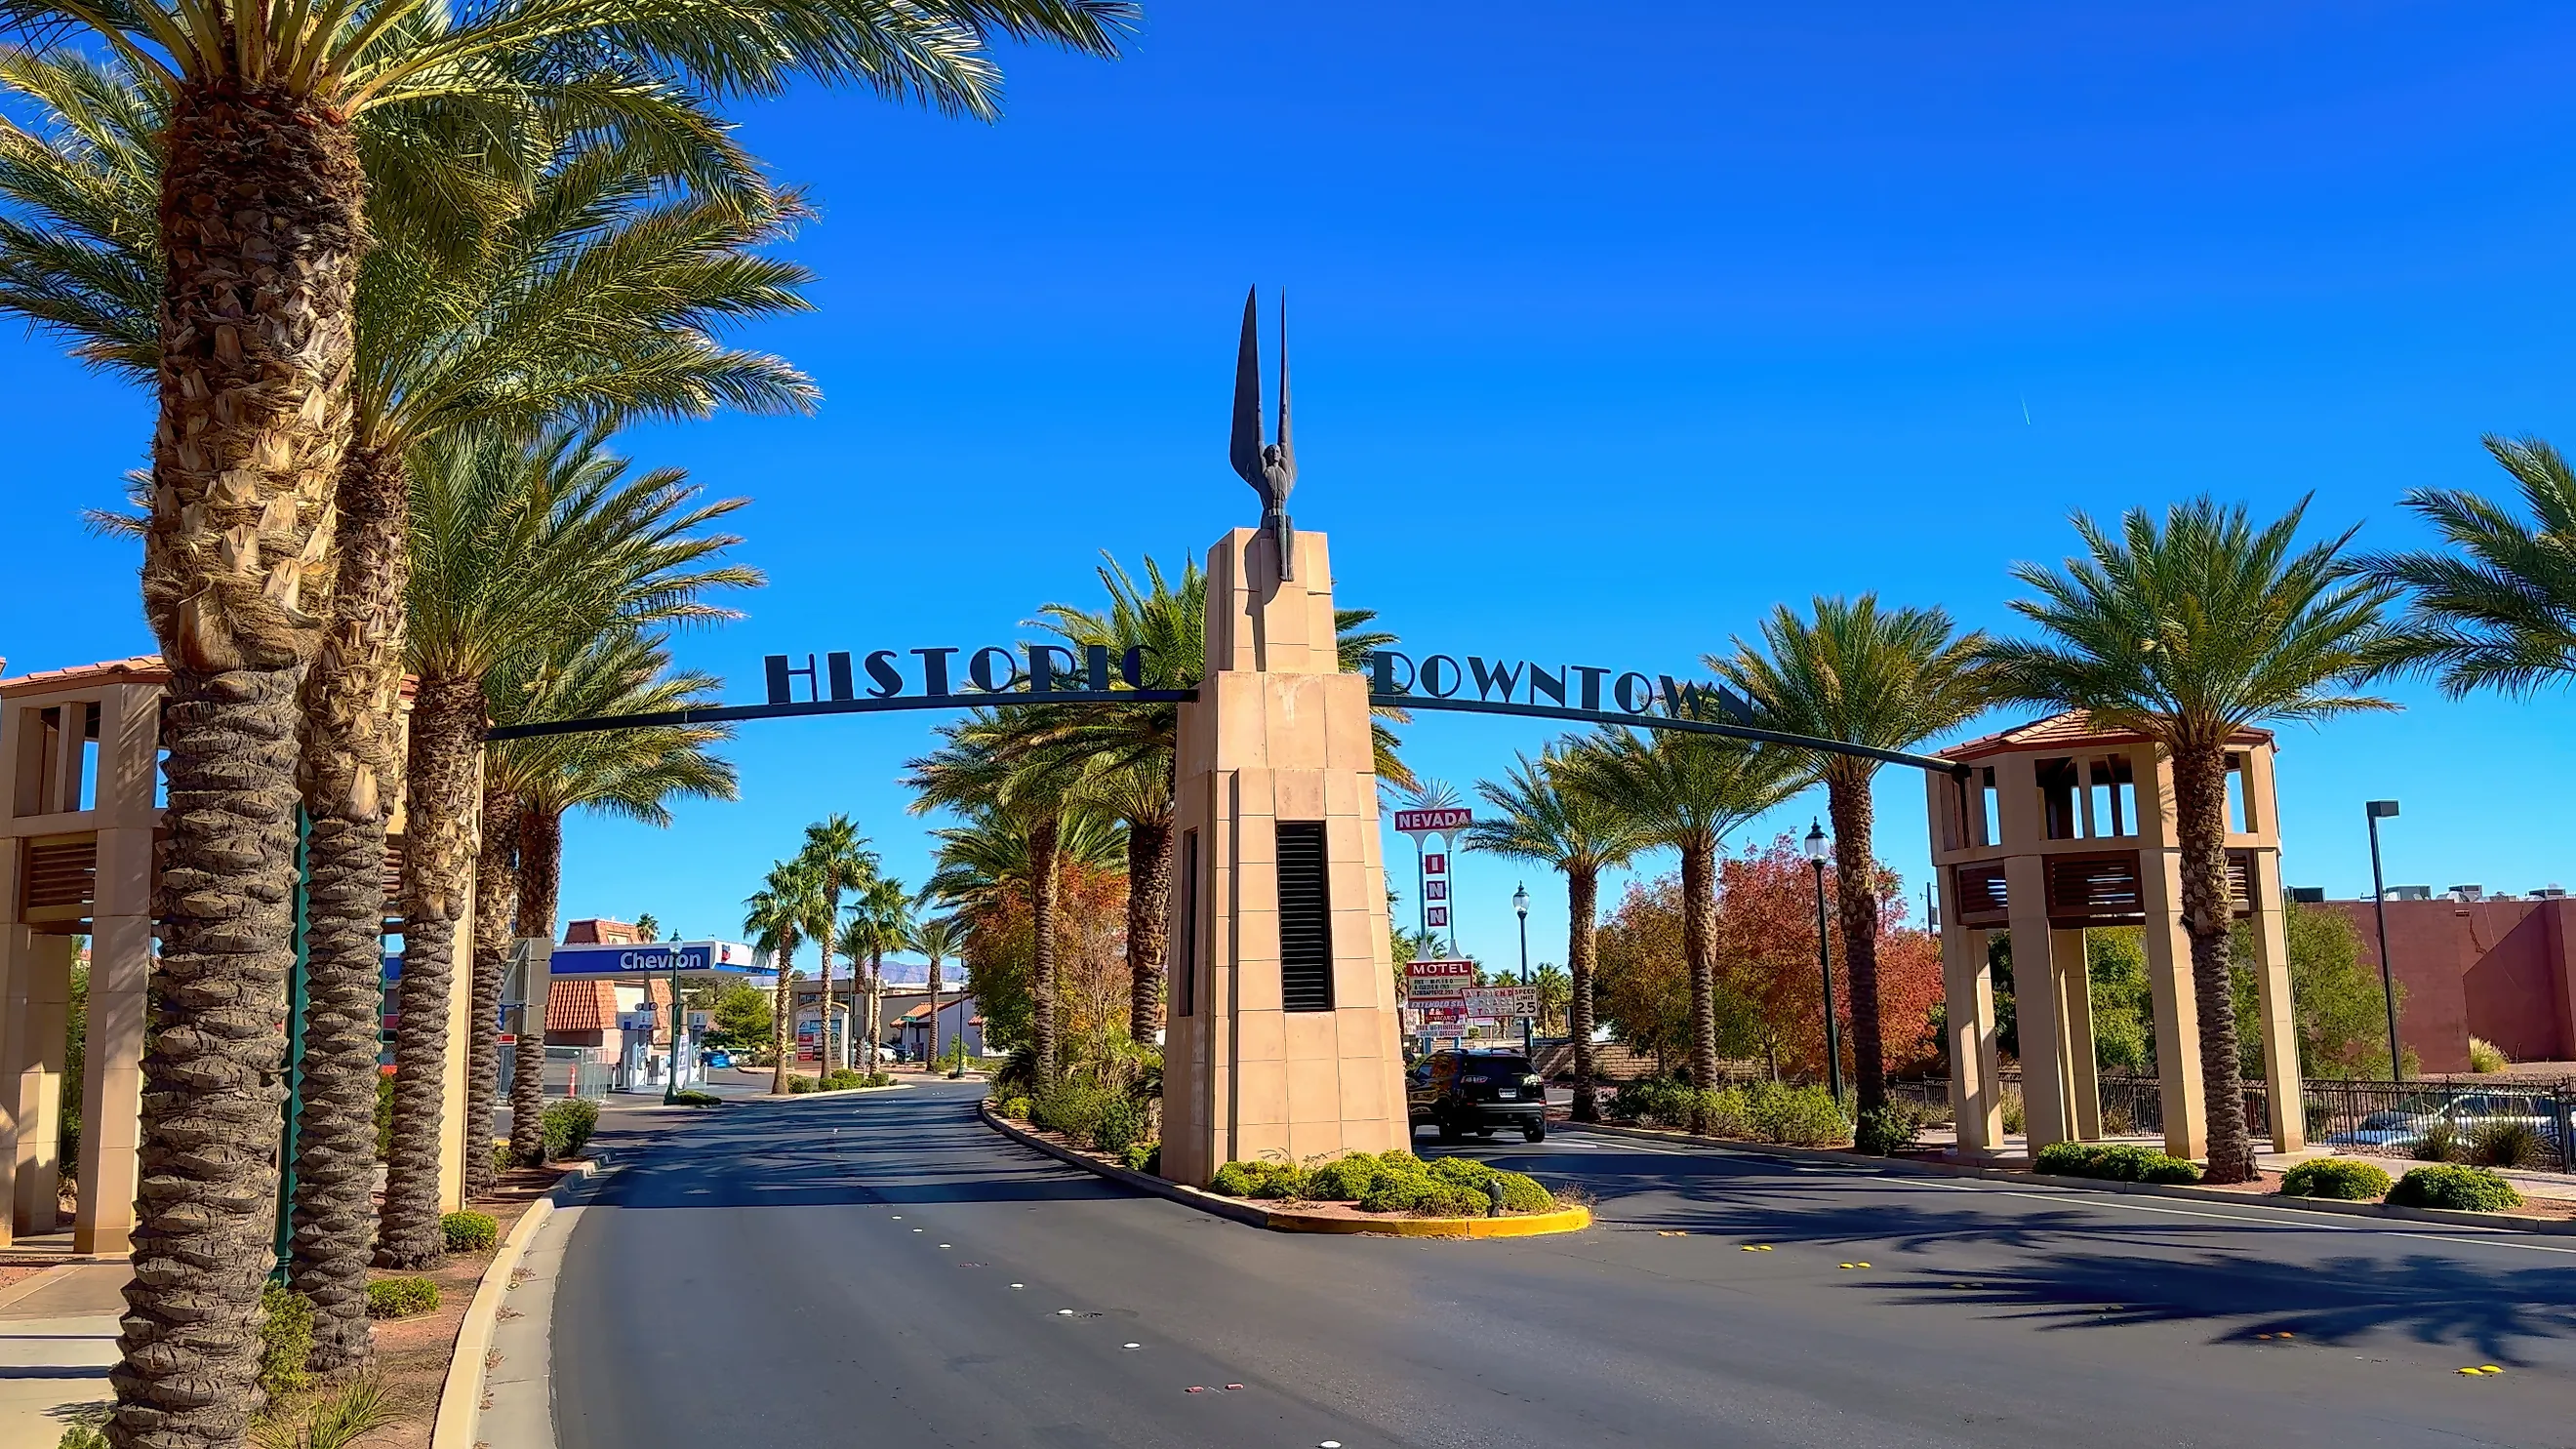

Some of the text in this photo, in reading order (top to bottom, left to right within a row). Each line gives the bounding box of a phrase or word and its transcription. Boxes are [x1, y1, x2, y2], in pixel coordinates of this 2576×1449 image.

[764, 644, 1752, 728] HISTORIC DOWNTOWN
[1398, 812, 1469, 828] NEVADA
[1429, 857, 1445, 924] INN
[620, 951, 702, 969] Chevron
[1413, 963, 1469, 974] MOTEL
[1515, 1002, 1536, 1014] 25
